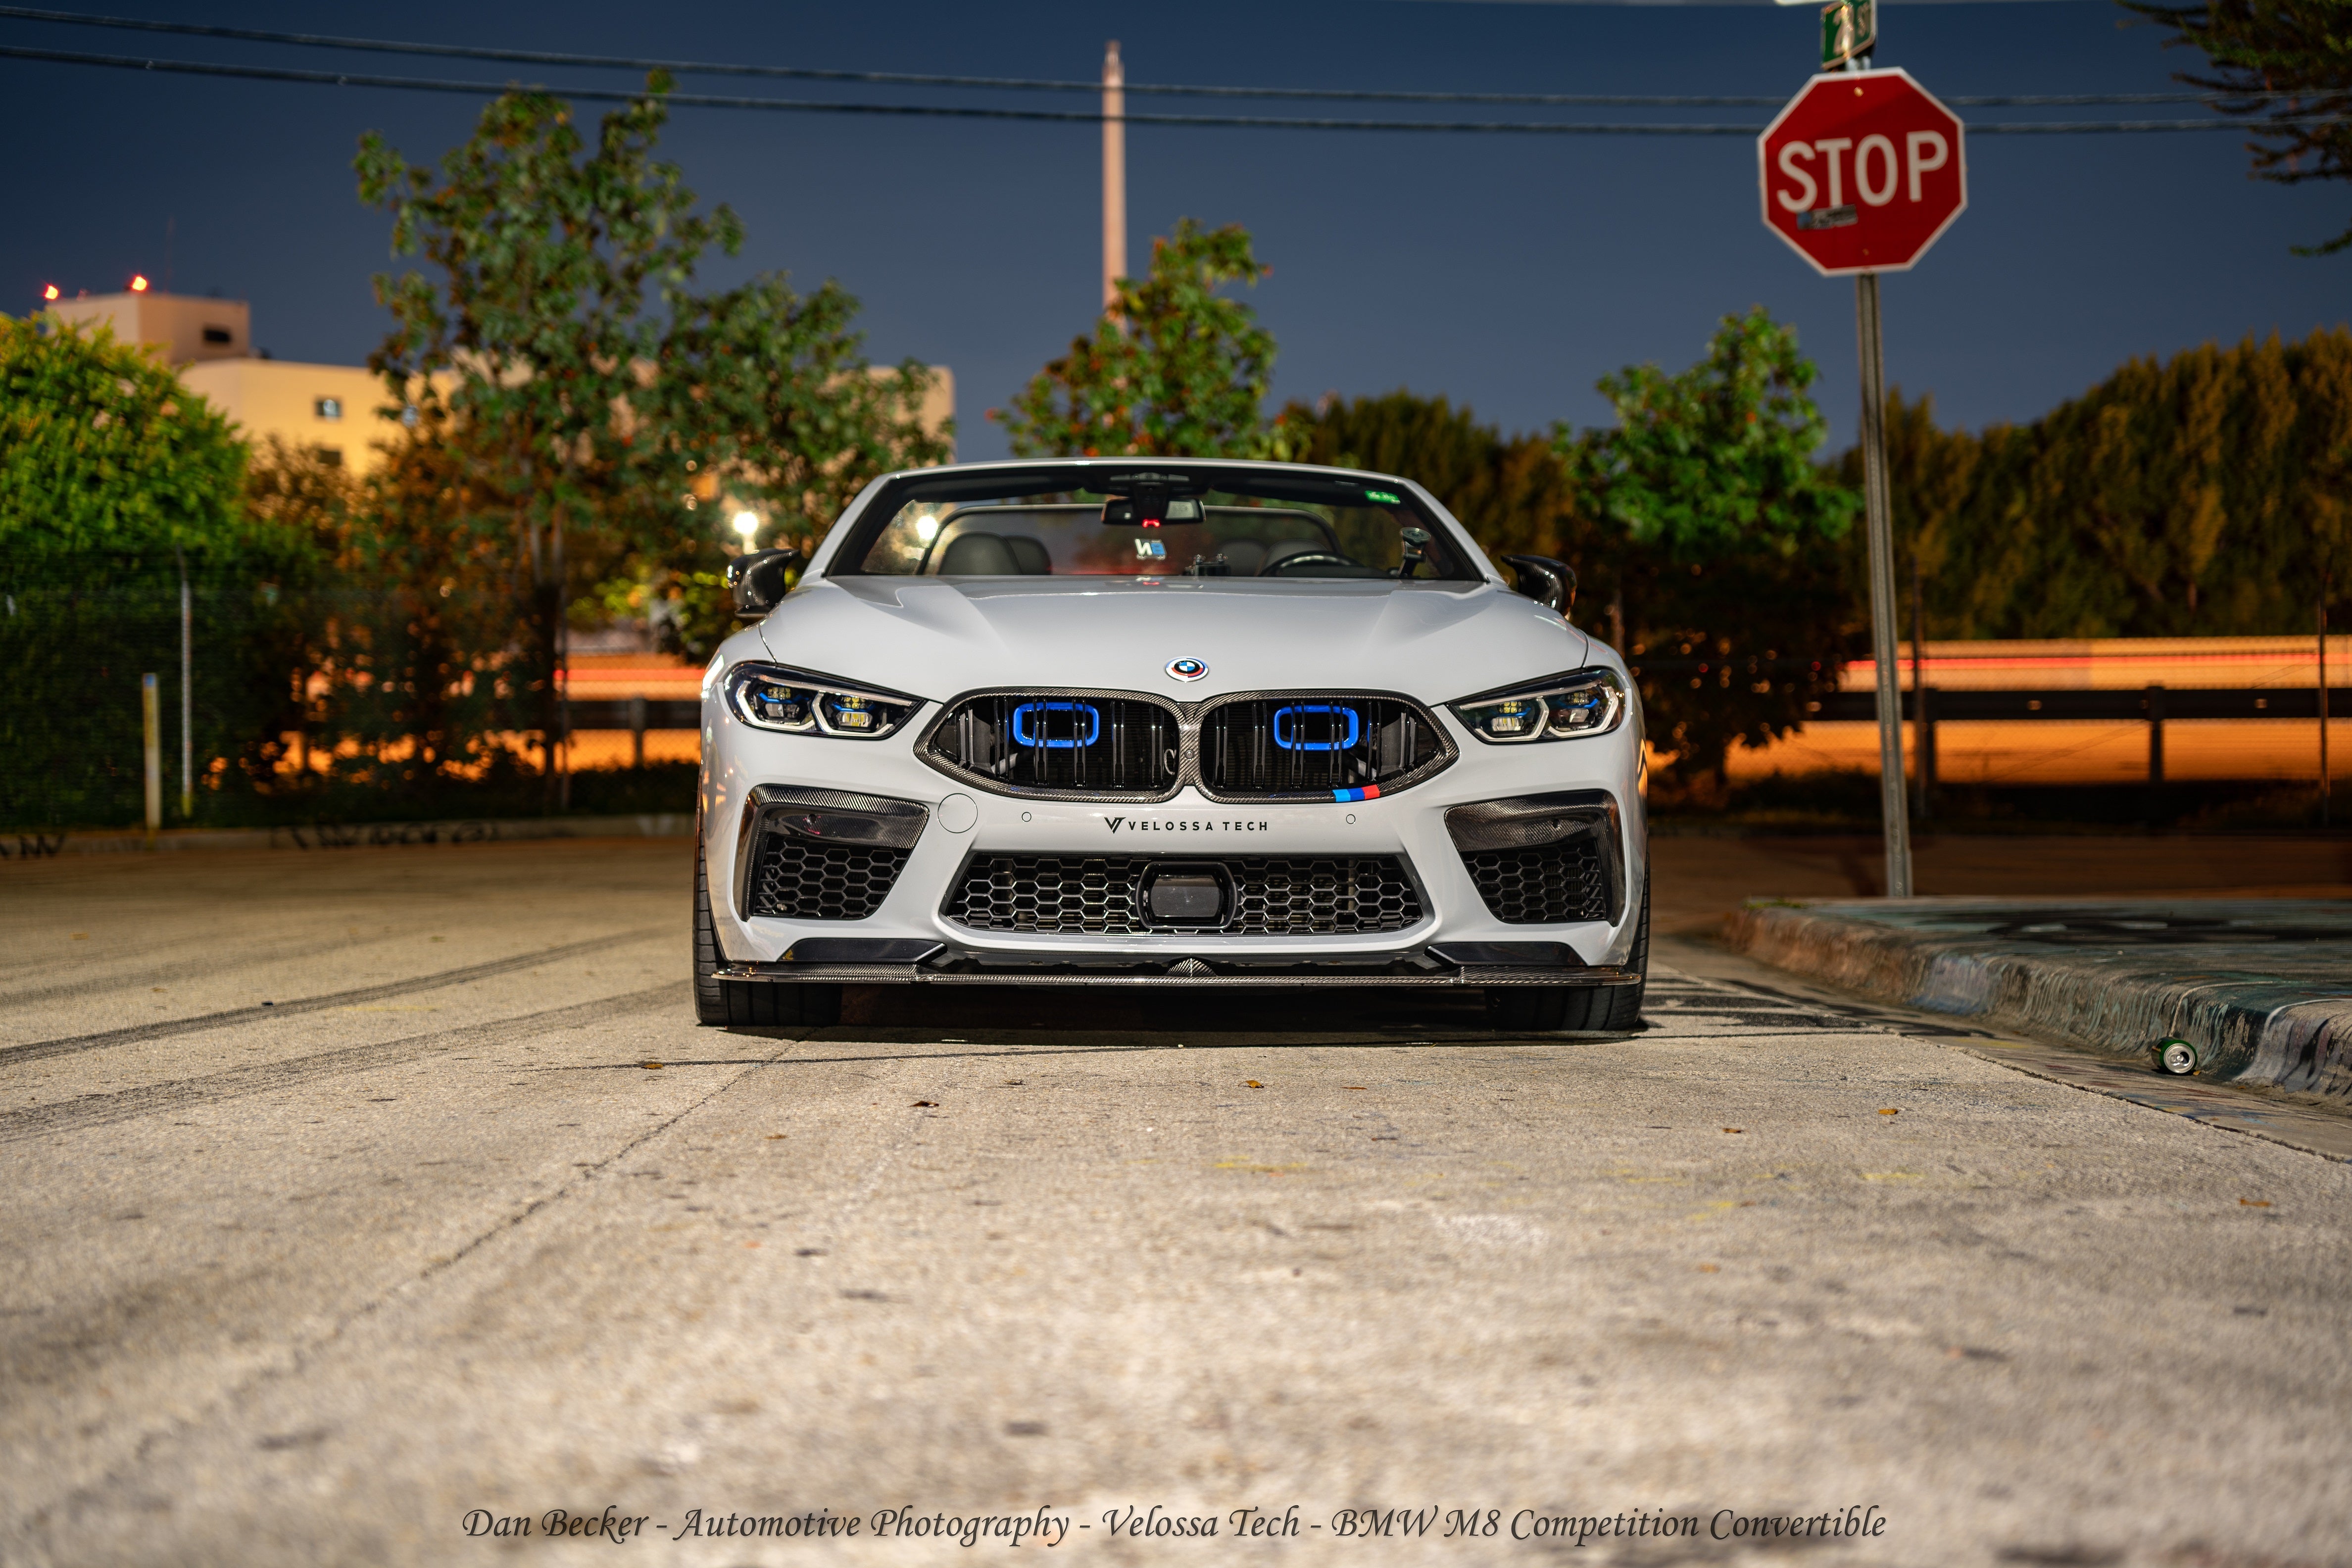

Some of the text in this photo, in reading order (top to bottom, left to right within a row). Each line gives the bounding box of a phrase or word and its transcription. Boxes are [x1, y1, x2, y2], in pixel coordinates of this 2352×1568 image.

[1776, 130, 1949, 213] STOP
[1128, 821, 1213, 831] VELOSSA
[1223, 821, 1267, 831] TECH
